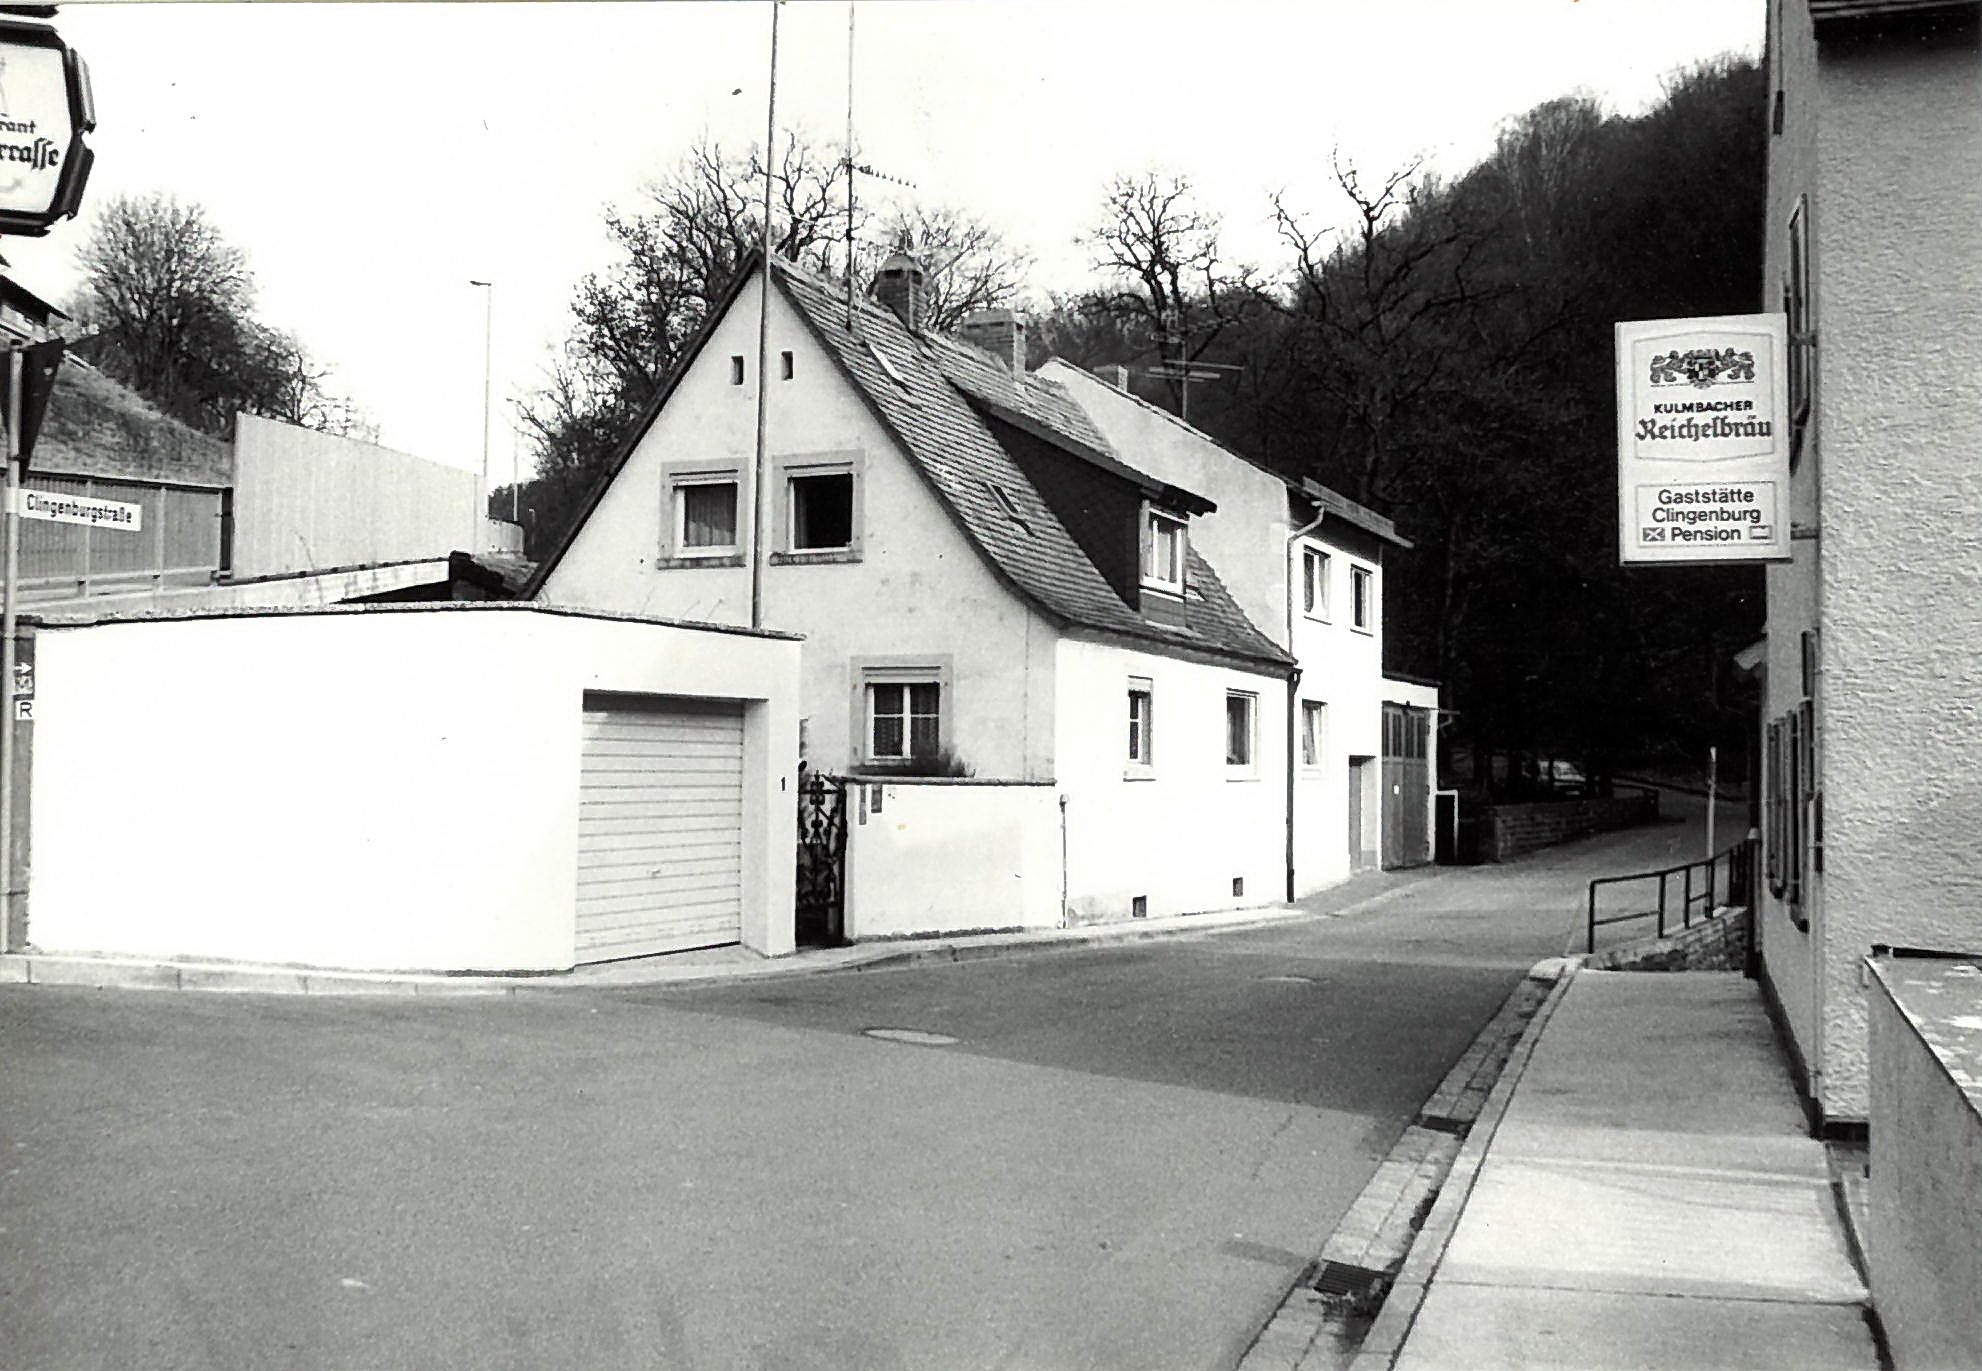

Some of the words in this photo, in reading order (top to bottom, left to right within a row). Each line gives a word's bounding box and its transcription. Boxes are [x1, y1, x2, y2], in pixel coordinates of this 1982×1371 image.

[1653, 400, 1753, 414] KULMBACHER
[1635, 415, 1772, 442] Reichelbräu
[1658, 488, 1755, 506] Gaststätte
[26, 493, 133, 523] Clingenburgstraße
[1652, 506, 1762, 524] Clingenburg
[1671, 526, 1741, 542] Pension
[19, 701, 33, 718] R
[780, 776, 786, 792] 1
